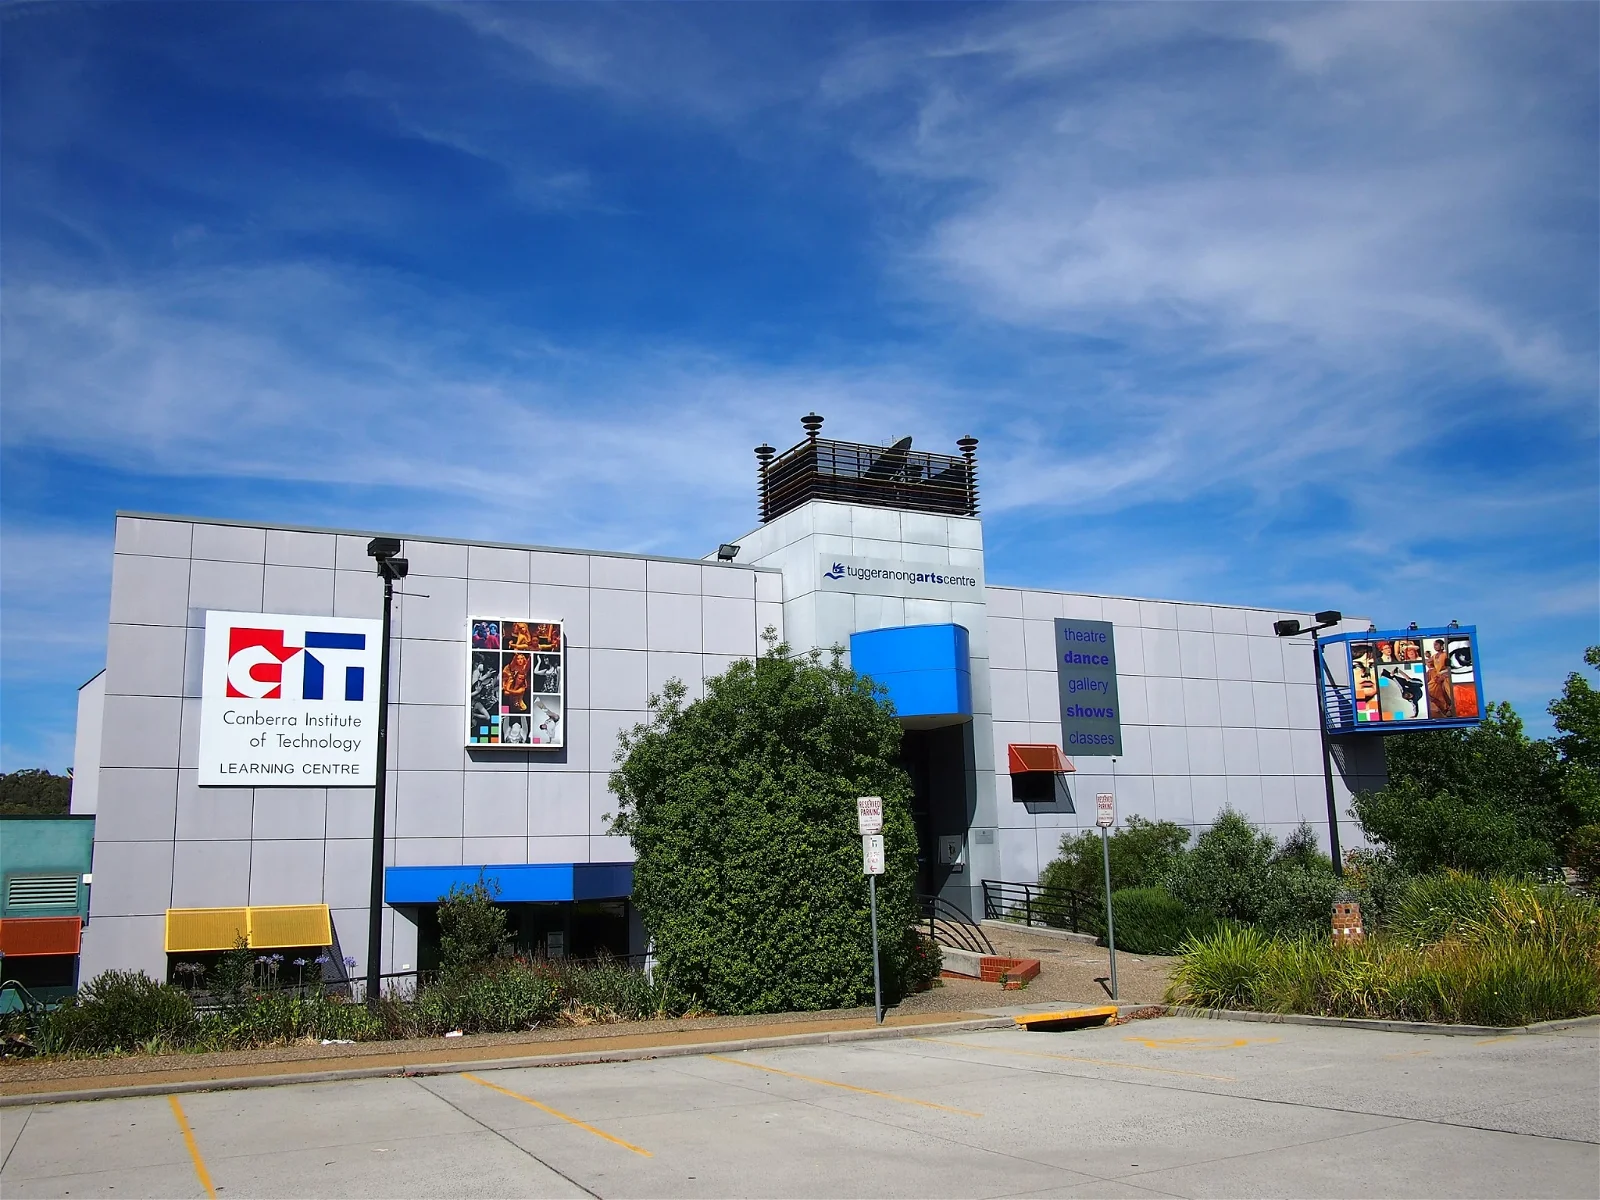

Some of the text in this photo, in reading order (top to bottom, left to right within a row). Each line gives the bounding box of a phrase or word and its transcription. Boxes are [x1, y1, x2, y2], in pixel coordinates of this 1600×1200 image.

[846, 564, 976, 587] tuggeranongartscentre
[1064, 628, 1106, 642] theatre
[1064, 651, 1109, 665] dance
[1069, 677, 1109, 694] gallery
[223, 709, 362, 727] Canberra Institute
[1067, 704, 1114, 718] shows
[249, 732, 267, 748] of
[277, 733, 362, 752] Technology
[1069, 731, 1115, 745] classes
[220, 763, 360, 775] LEARNING CENTRE
